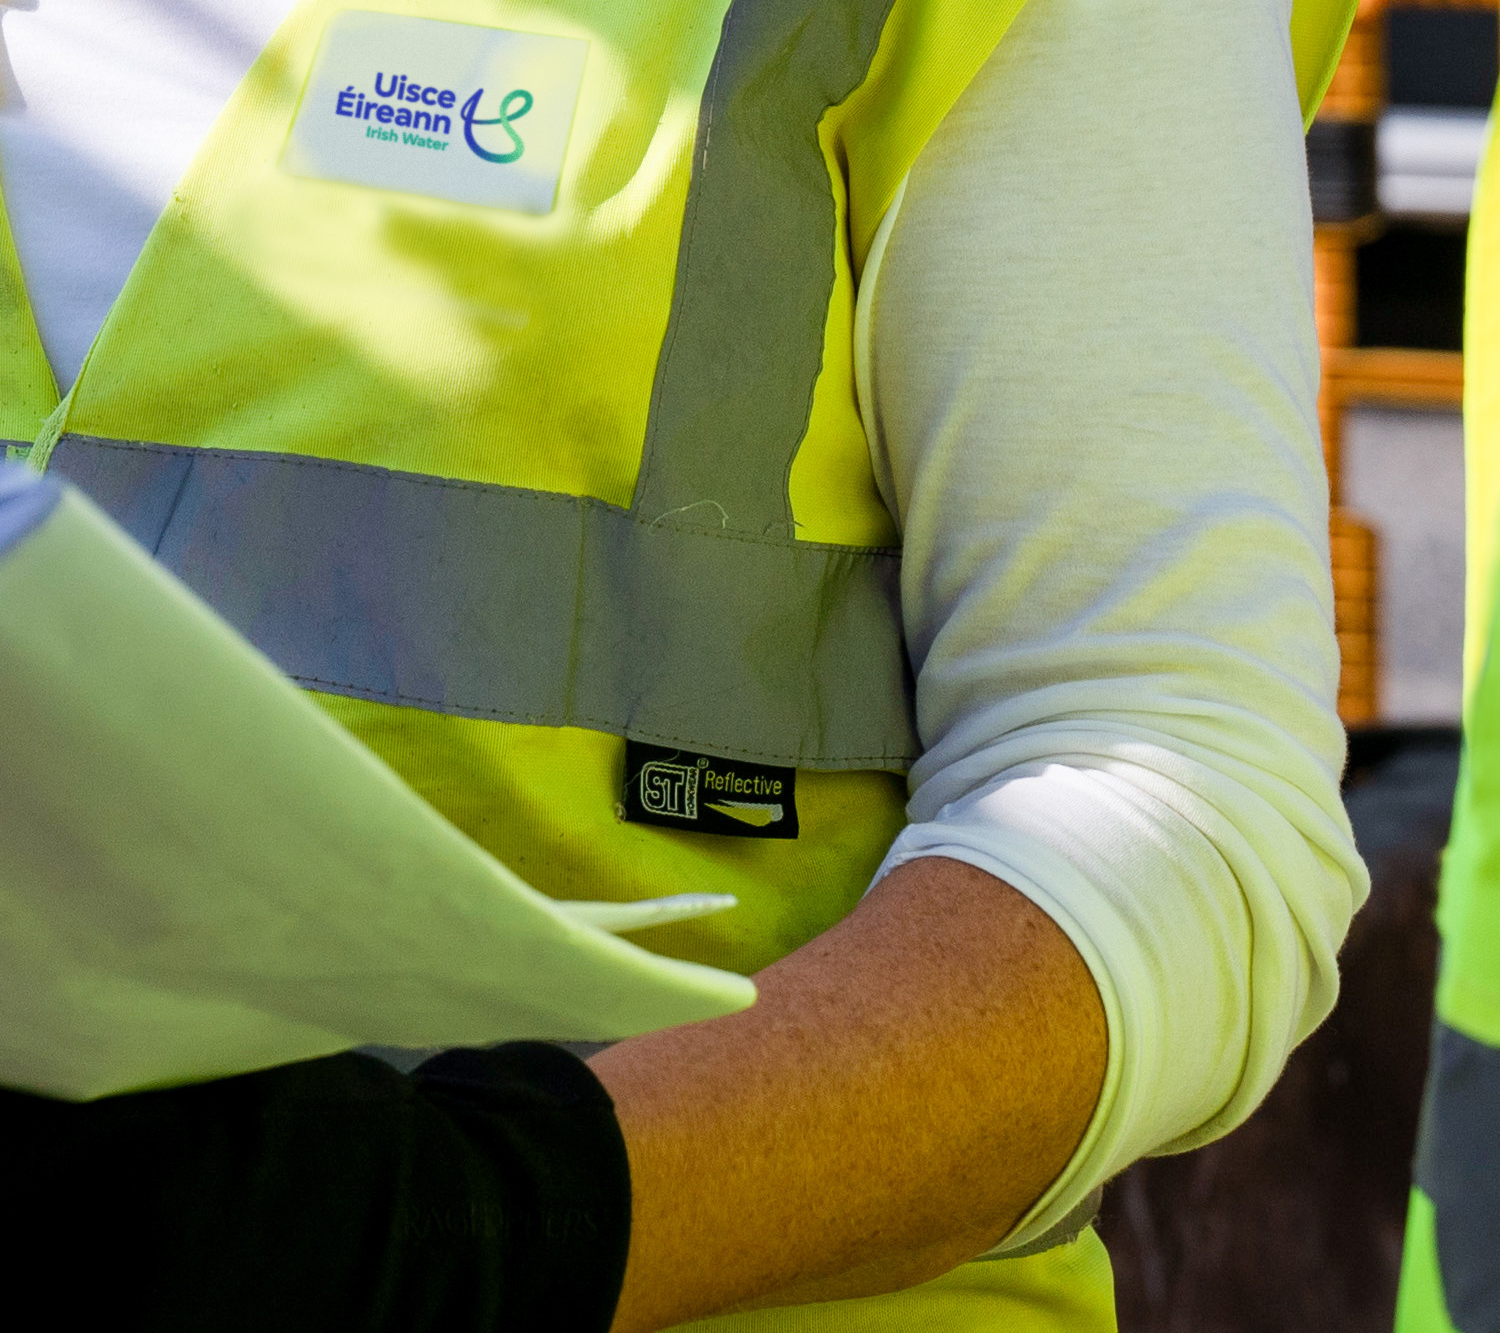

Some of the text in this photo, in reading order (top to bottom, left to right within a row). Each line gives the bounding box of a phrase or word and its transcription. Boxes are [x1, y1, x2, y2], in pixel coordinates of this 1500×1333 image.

[374, 71, 457, 109] Uisce
[334, 85, 452, 135] Éireann
[364, 125, 450, 152] Irish Water
[704, 770, 783, 796] Reflective
